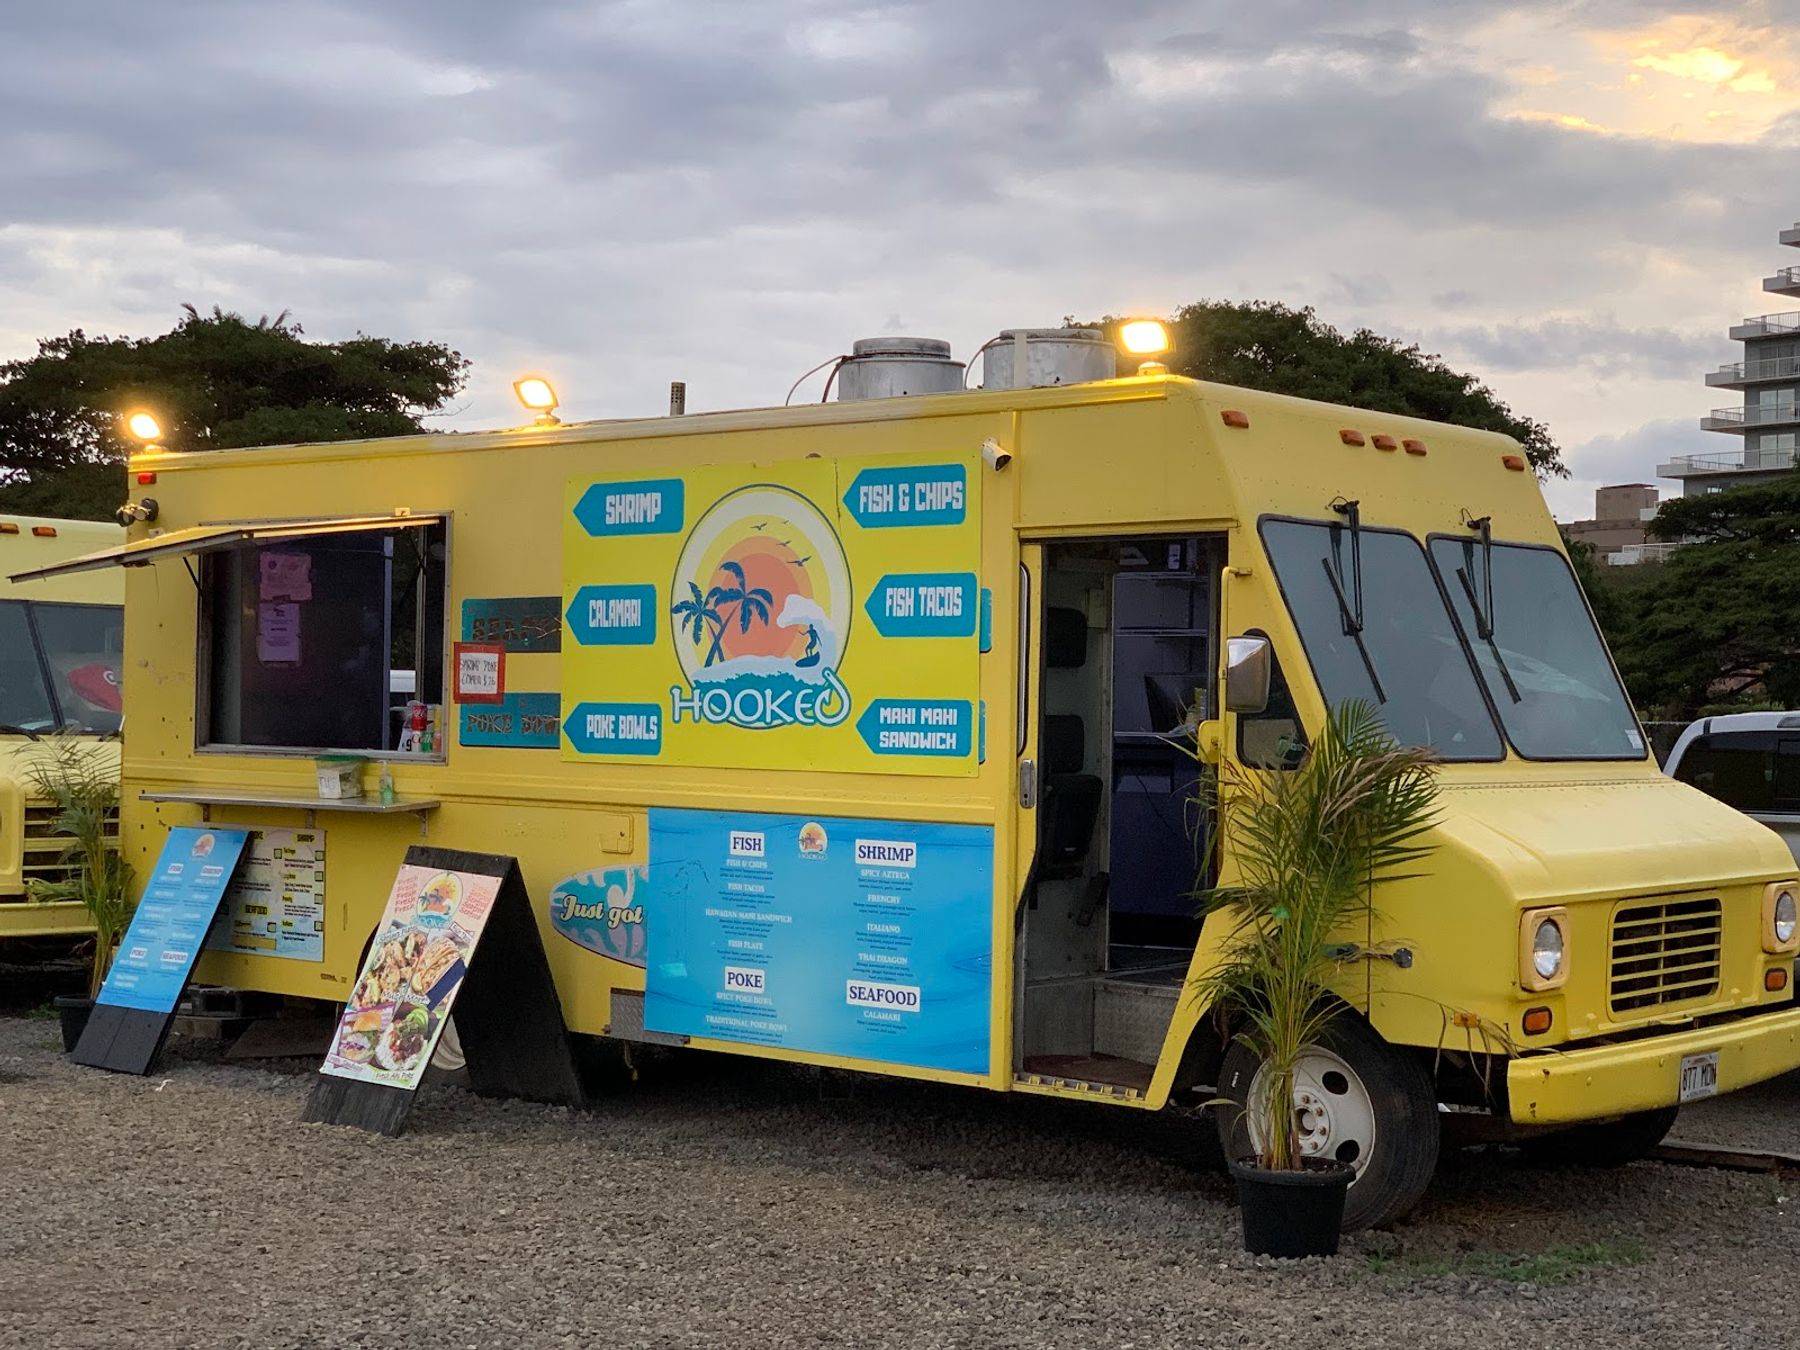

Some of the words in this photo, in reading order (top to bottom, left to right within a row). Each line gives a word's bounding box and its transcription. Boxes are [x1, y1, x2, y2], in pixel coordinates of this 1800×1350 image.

[605, 492, 662, 525] SHRIMP
[859, 487, 892, 514] FISH
[898, 486, 910, 512] &
[914, 481, 963, 511] CHIPS
[588, 599, 641, 627] CALAMARI
[885, 587, 915, 617] FISH
[919, 586, 962, 617] TACOS
[671, 669, 850, 724] HOOKED
[586, 714, 616, 740] POKE
[618, 715, 658, 741] BOWLS
[880, 707, 917, 726] MAHI
[920, 708, 958, 726] MAHI
[879, 732, 957, 750] SANDWICH
[732, 836, 762, 852] FISH
[858, 844, 914, 862] SHRIMP
[560, 894, 605, 921] Just
[607, 905, 644, 929] got
[727, 972, 762, 988] POKE
[849, 985, 917, 1006] SEAFOOD
